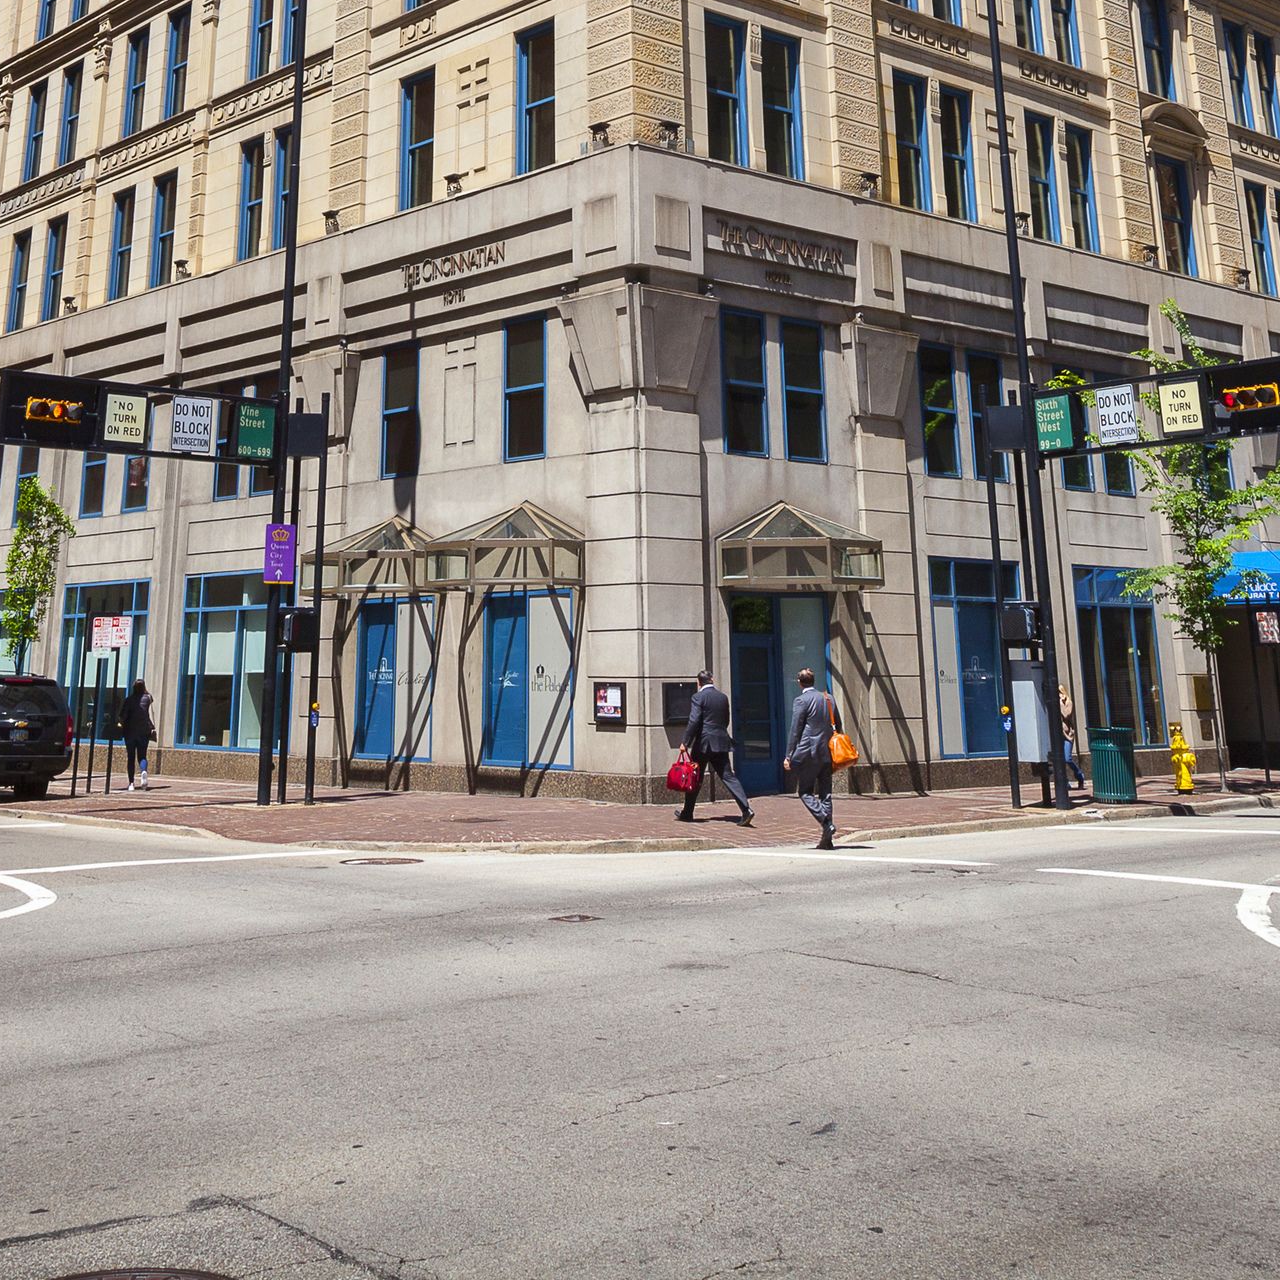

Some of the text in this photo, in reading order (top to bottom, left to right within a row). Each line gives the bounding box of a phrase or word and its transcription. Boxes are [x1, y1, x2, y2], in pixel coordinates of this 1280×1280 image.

[716, 219, 843, 265] THE CINCINNATIAN
[401, 241, 506, 289] THE CINCINNATIAN
[1099, 392, 1131, 408] DO NOT
[1171, 389, 1186, 399] NO
[118, 402, 134, 412] NO
[176, 403, 211, 418] DO NOT
[241, 405, 259, 417] Vine
[1036, 399, 1058, 411] Sixth
[1169, 402, 1190, 412] TURN
[113, 413, 137, 424] TURN
[240, 416, 266, 428] Street
[1038, 410, 1064, 422] Street
[1100, 410, 1134, 426] BLOCK
[1166, 414, 1198, 425] ON RED
[107, 425, 141, 437] ON RED
[174, 421, 209, 436] BLOCK
[1039, 422, 1061, 433] West
[1101, 426, 1136, 439] INTERSECTION
[173, 437, 209, 448] INTERSECTION
[1040, 438, 1061, 450] 99-0
[238, 445, 271, 457] 600-699
